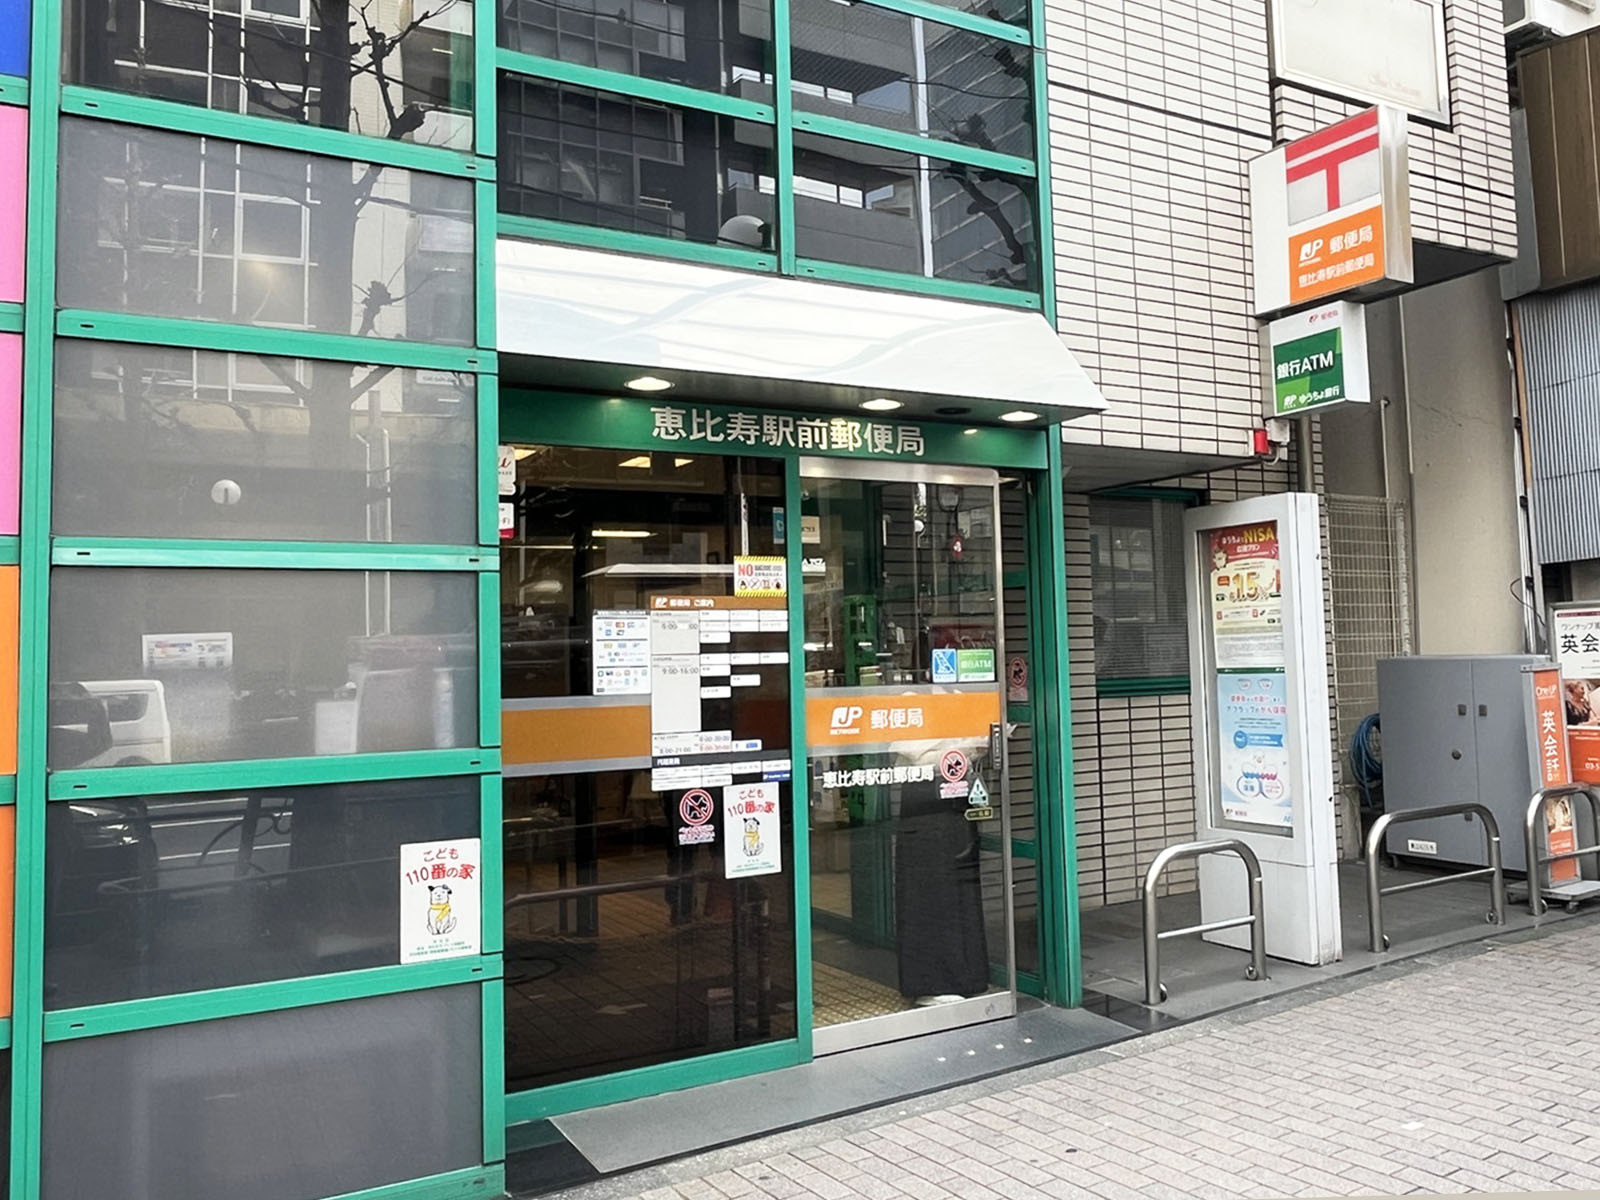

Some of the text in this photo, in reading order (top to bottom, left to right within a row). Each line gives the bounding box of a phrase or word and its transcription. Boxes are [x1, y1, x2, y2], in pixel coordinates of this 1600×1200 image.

[1329, 224, 1373, 254] 郵便局
[1276, 350, 1334, 380] 銀行ATM
[1298, 385, 1340, 404] ゆうちょ銀行
[650, 406, 925, 456] 恵比寿駅前郵便局
[737, 563, 754, 577] NO
[1560, 633, 1600, 654] 英会
[871, 707, 923, 729] 郵便局
[1541, 710, 1560, 782] 英会話
[822, 765, 935, 789] 恵比寿駅前郵便局
[738, 788, 765, 800] こども
[727, 800, 776, 818] 110番の家
[422, 847, 460, 863] こども
[405, 862, 476, 886] 110番の家
